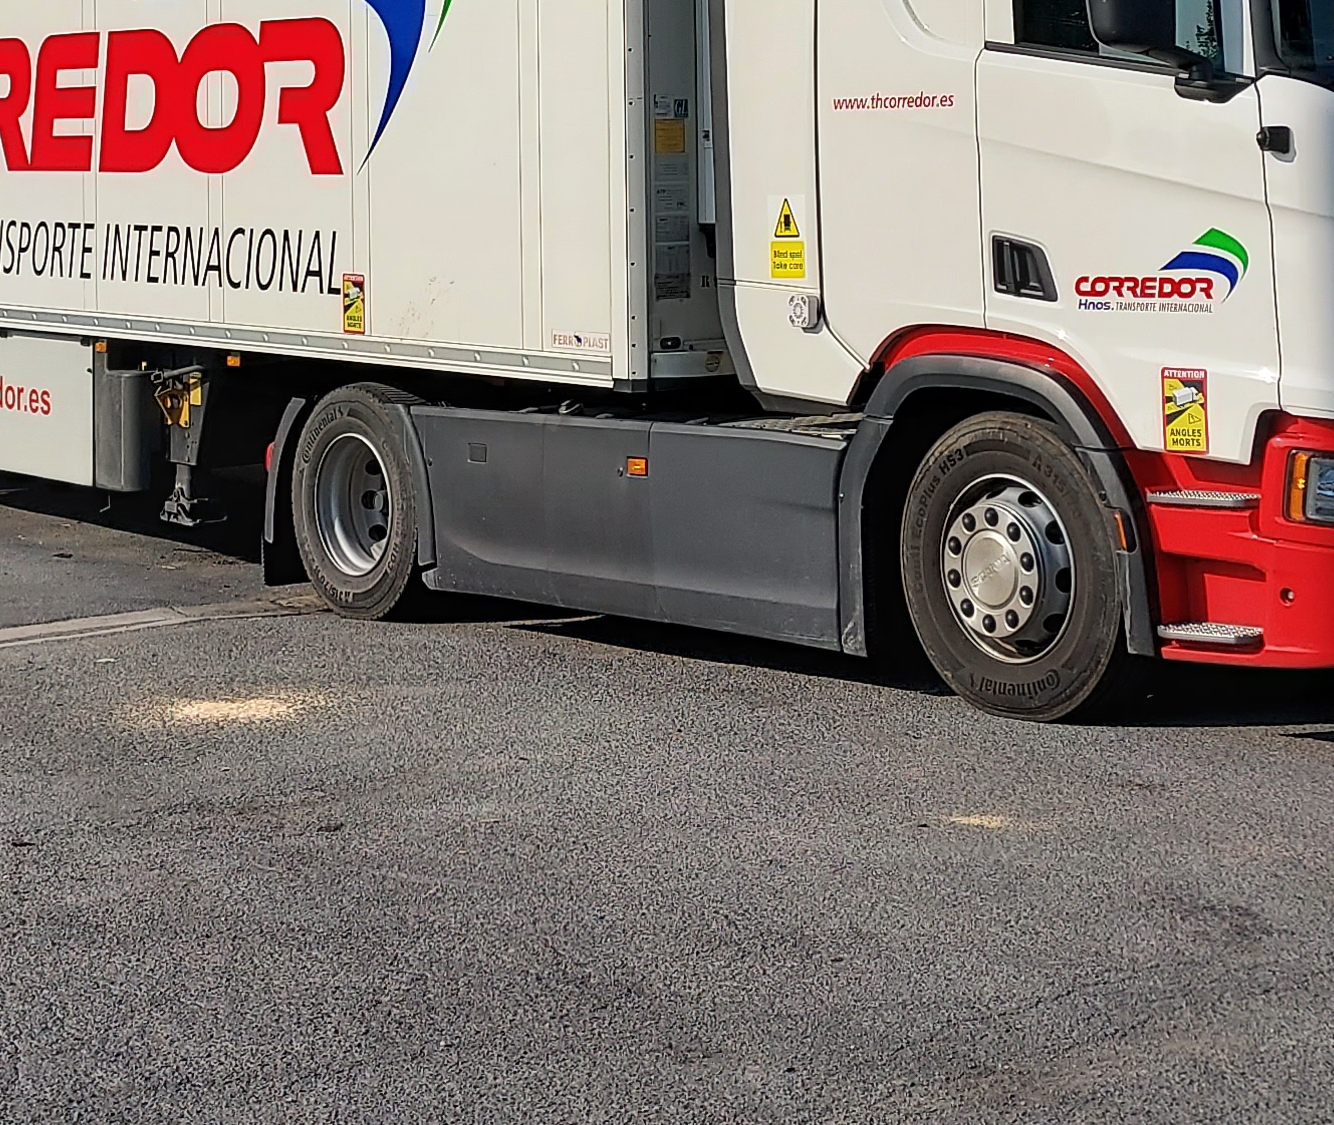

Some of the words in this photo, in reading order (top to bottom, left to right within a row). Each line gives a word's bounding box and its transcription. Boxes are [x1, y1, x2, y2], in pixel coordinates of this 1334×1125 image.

[833, 91, 954, 110] www.thcorredor.es
[102, 222, 341, 295] INTERNACIONAL
[1075, 276, 1213, 299] CORREDOR
[1078, 299, 1114, 311] Hnos.
[1115, 302, 1157, 312] TRANSPORTE
[1159, 303, 1213, 313] INTERNACIONAL
[1164, 369, 1205, 379] ATTENTION
[1170, 428, 1202, 437] ANGLES
[1172, 438, 1201, 446] MORTS
[938, 447, 965, 476] HS3
[979, 668, 1061, 700] Continental
